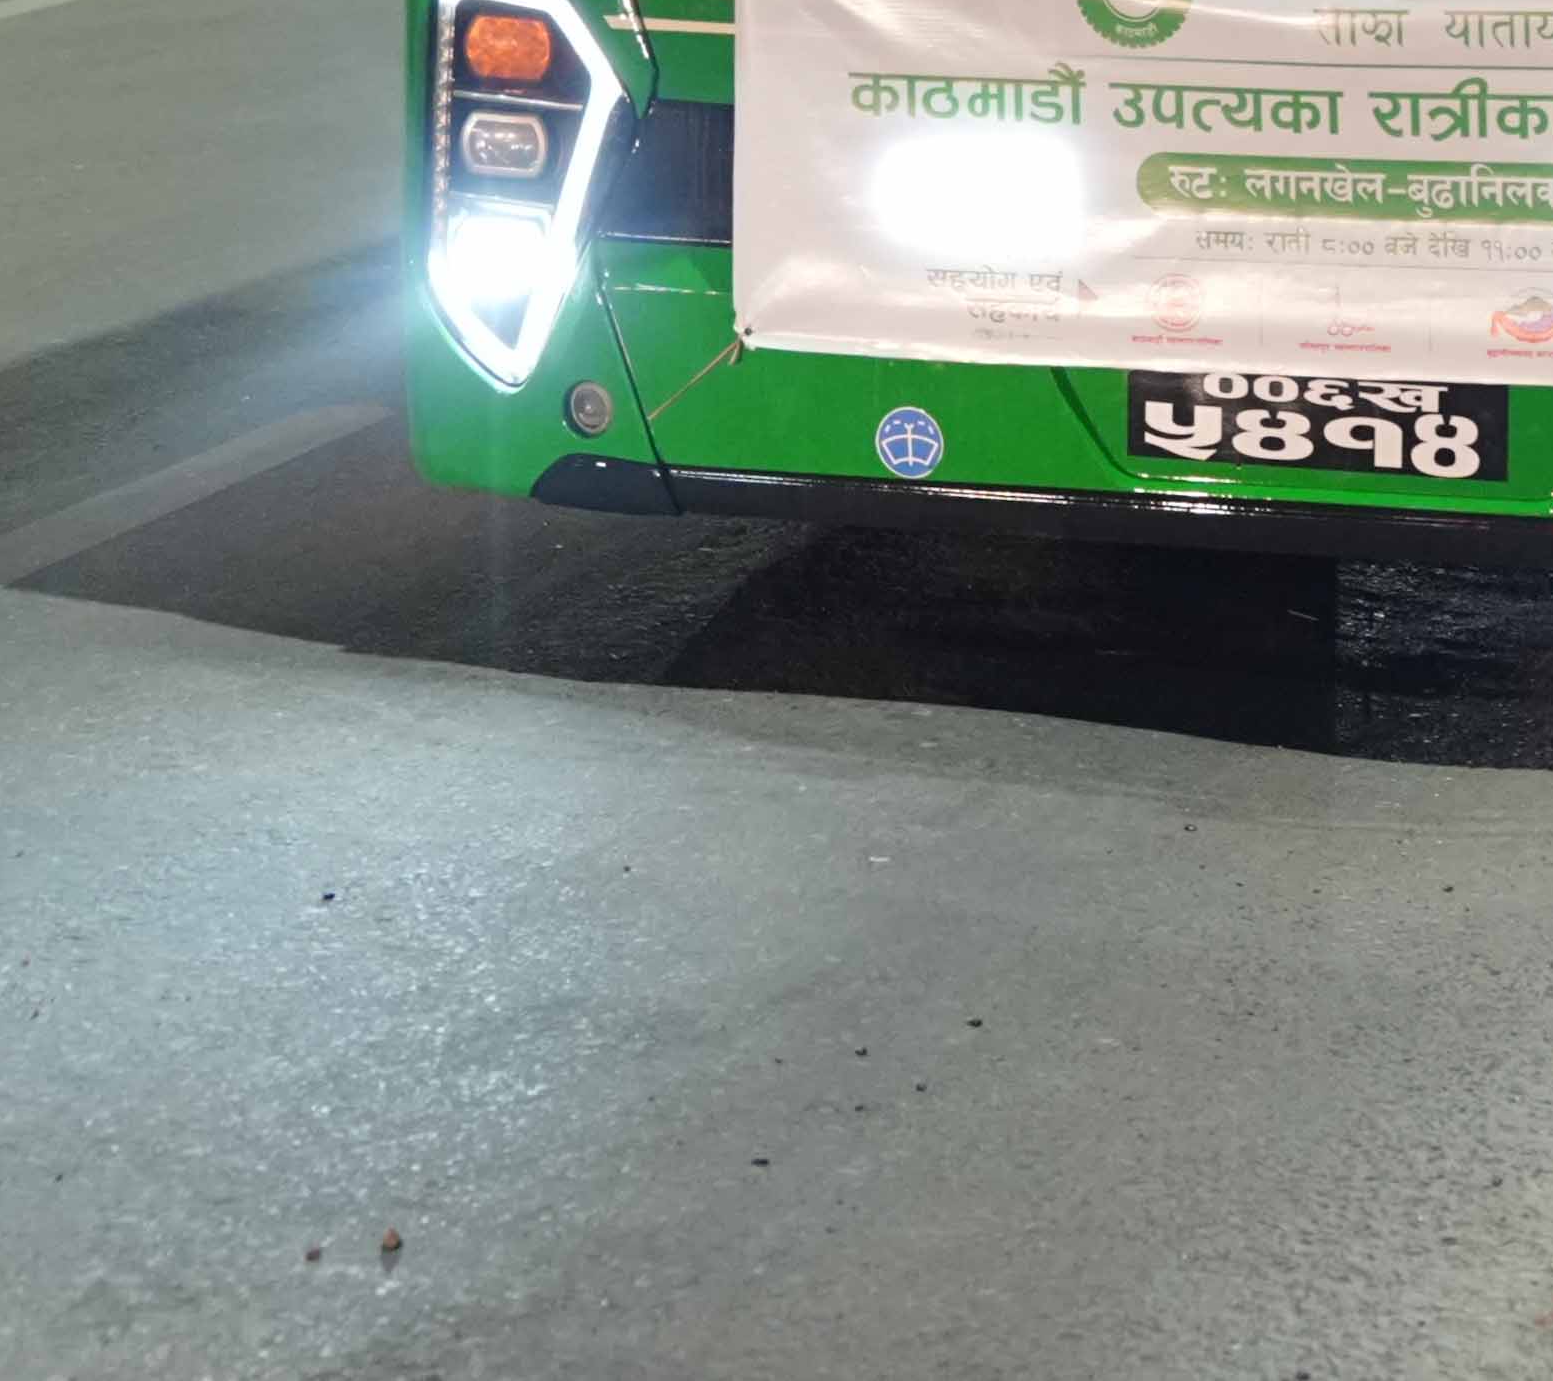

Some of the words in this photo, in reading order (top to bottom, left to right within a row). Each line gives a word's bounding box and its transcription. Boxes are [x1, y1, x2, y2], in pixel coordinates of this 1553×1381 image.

[1108, 81, 1344, 135] उपत्यका
[1263, 227, 1312, 254] राती
[1384, 232, 1419, 257] बजे
[1427, 232, 1471, 259] देखि
[927, 265, 1017, 291] सहयोग
[1143, 400, 1481, 479] ५४१४
